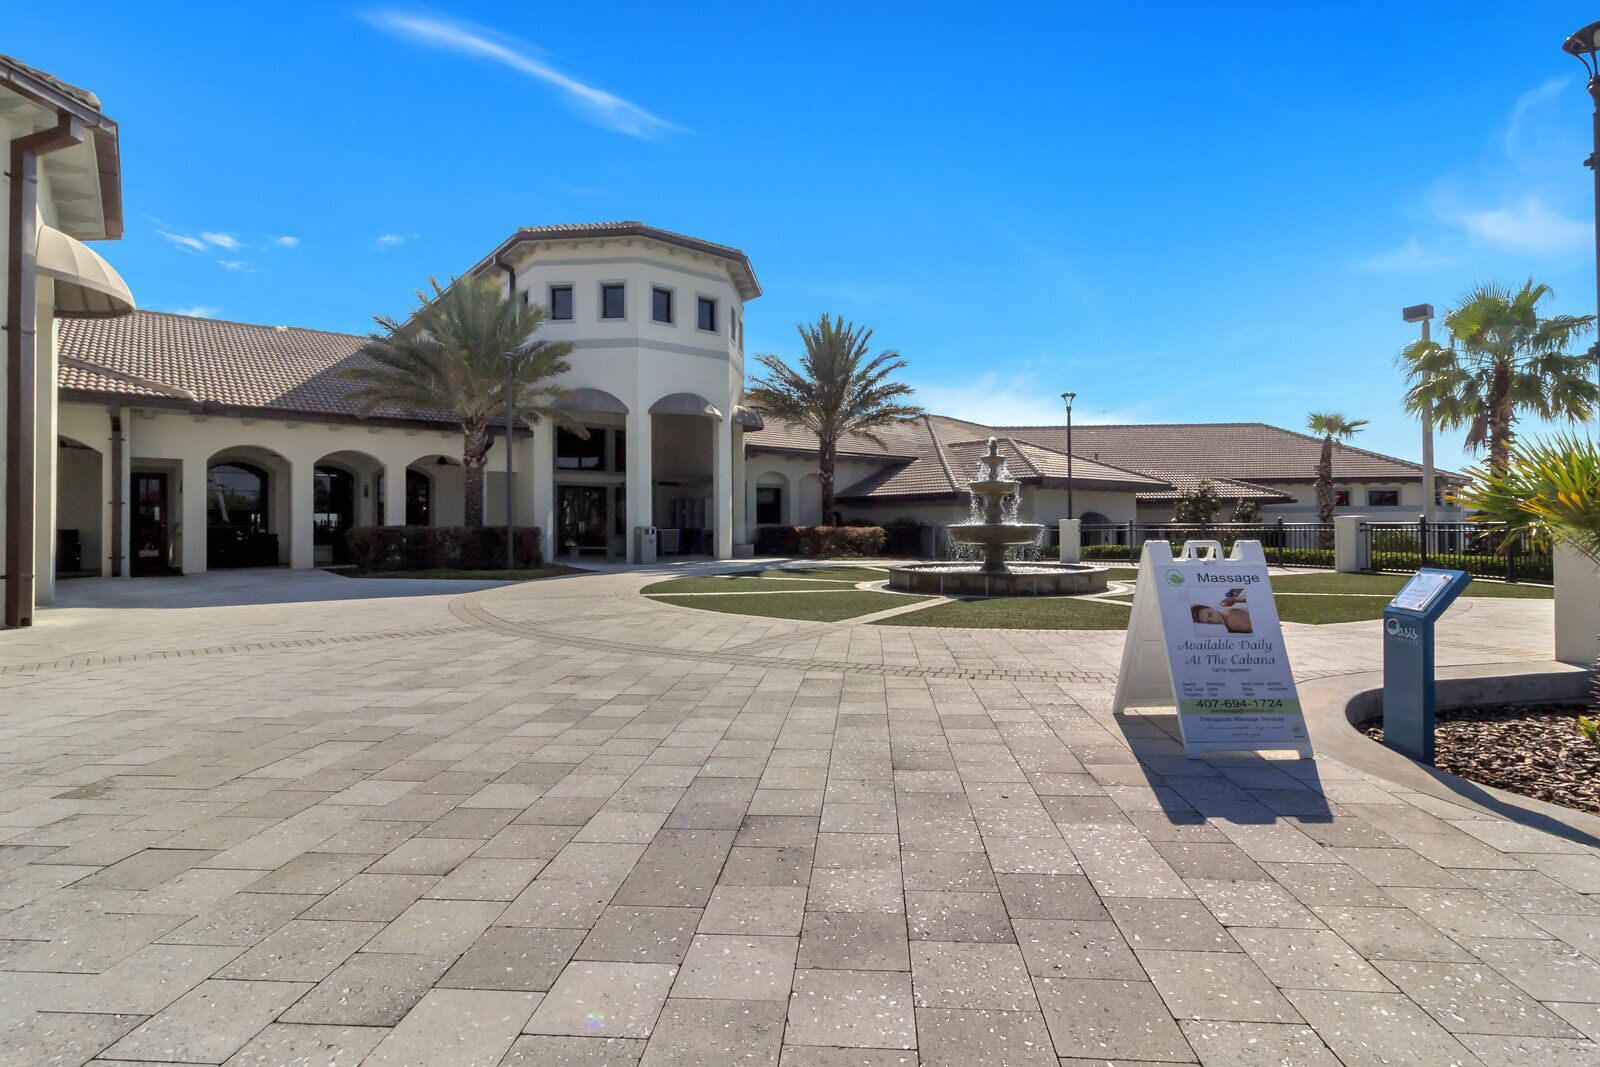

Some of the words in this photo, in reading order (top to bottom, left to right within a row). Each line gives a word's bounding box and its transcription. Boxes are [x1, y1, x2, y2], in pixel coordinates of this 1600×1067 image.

[1197, 573, 1260, 585] Massage
[1386, 618, 1418, 640] Oasis
[1177, 638, 1234, 651] Available
[1237, 638, 1273, 653] Daily
[1185, 655, 1201, 665] At
[1204, 653, 1227, 665] The
[1231, 653, 1276, 665] Cabana
[1196, 699, 1282, 708] 407-694-1724
